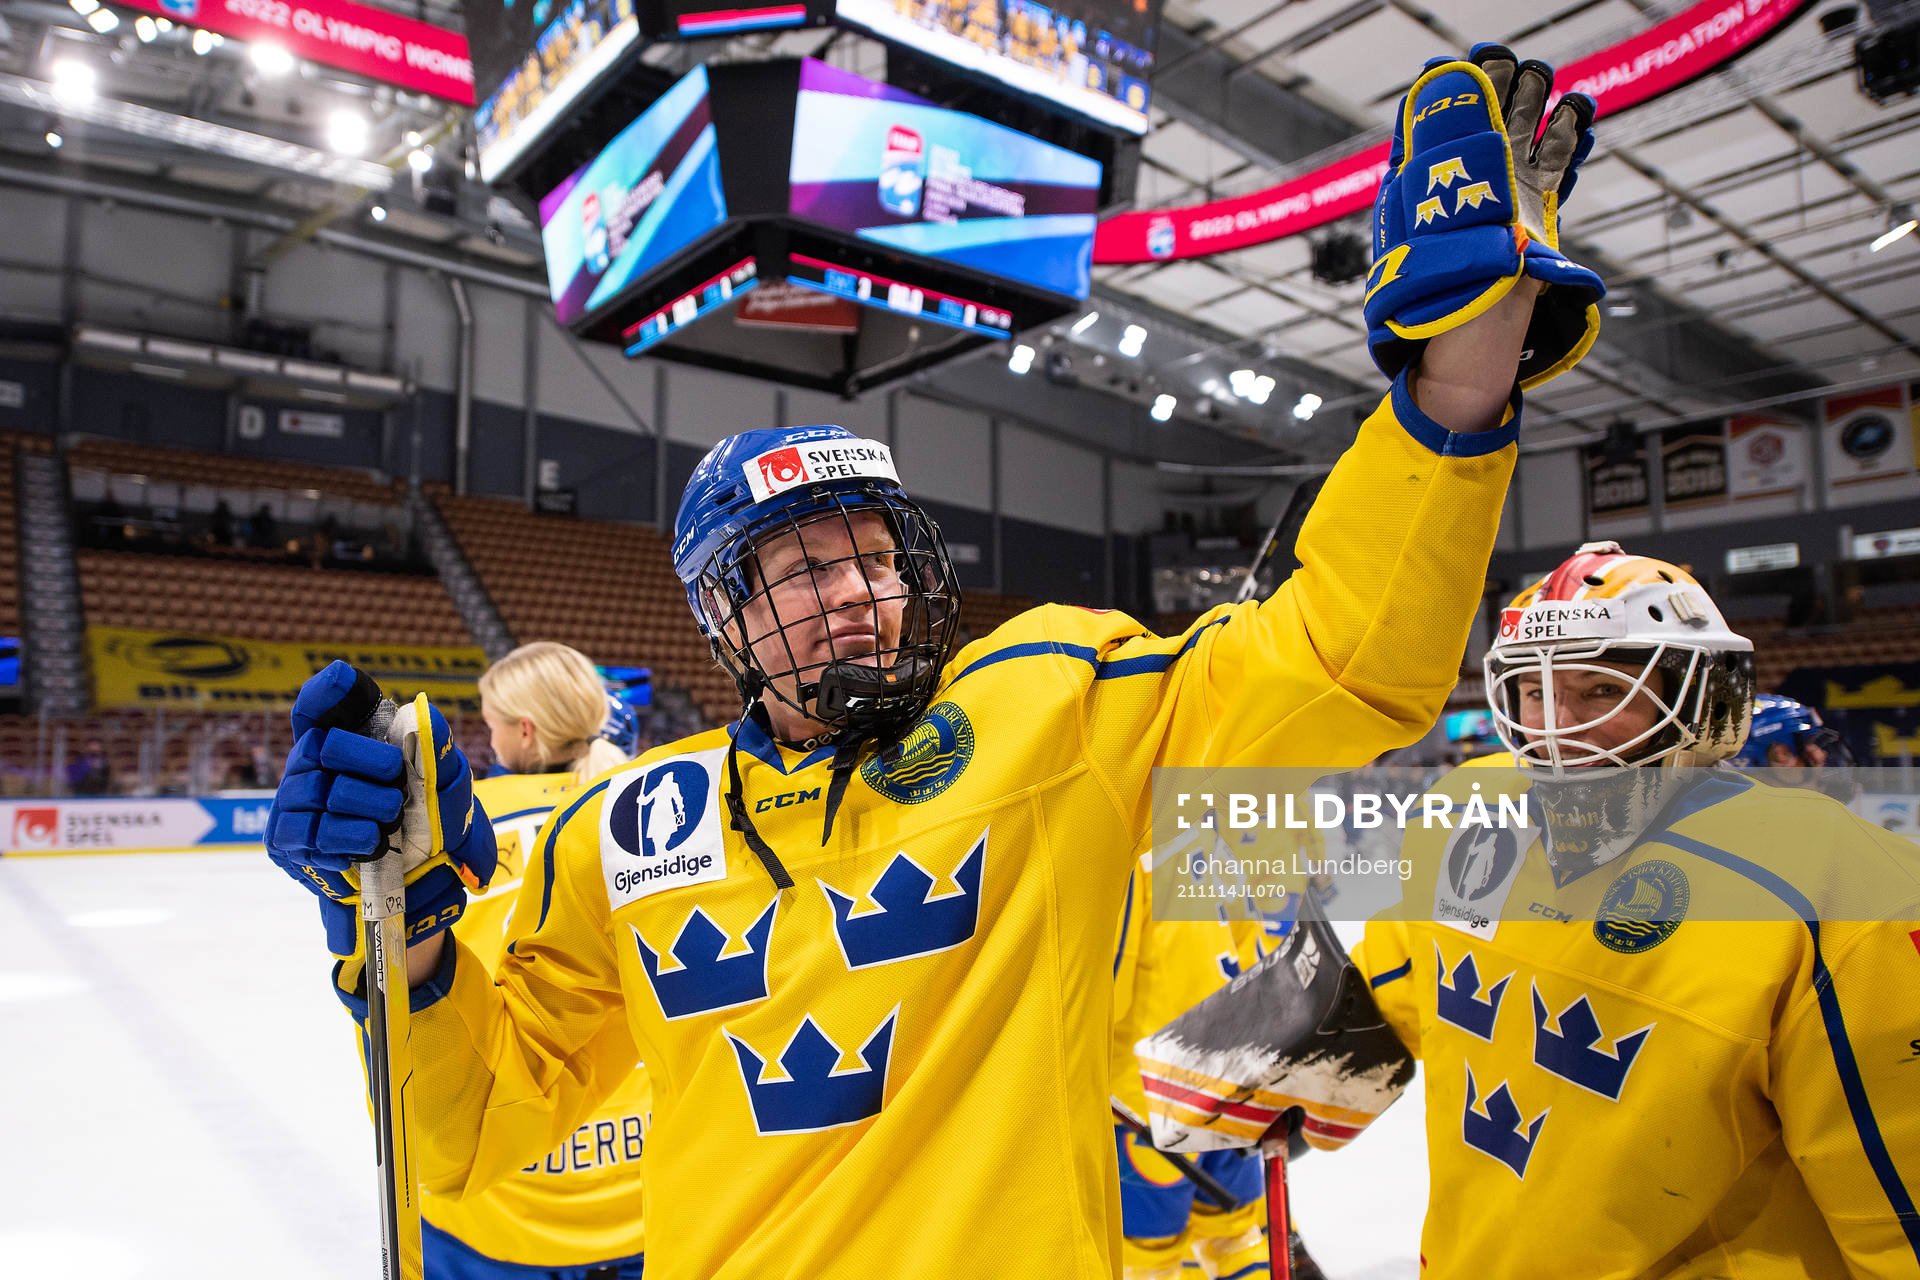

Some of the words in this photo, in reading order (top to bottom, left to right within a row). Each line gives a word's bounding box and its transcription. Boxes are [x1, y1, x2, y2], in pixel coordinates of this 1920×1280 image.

[293, 8, 402, 61] OLYMPIC
[1569, 5, 1745, 96] QUALIFICATION
[1413, 93, 1479, 129] CCM
[1190, 215, 1236, 241] 2022
[1235, 192, 1312, 231] OLYMPIC
[240, 405, 265, 440] D
[784, 430, 848, 443] CCM
[807, 447, 889, 465] SVENSKA
[814, 463, 862, 480] SPEL
[674, 525, 695, 565] CCM
[1525, 607, 1611, 625] SVENSKA
[1524, 624, 1568, 640] SPEL
[756, 787, 821, 813] CCM
[66, 813, 163, 828] SVENSKA
[66, 832, 114, 845] SPEL
[615, 854, 713, 894] Gjensidige
[1438, 898, 1490, 929] Gjensidige
[1528, 902, 1574, 924] CCM
[521, 1112, 652, 1174] DERB
